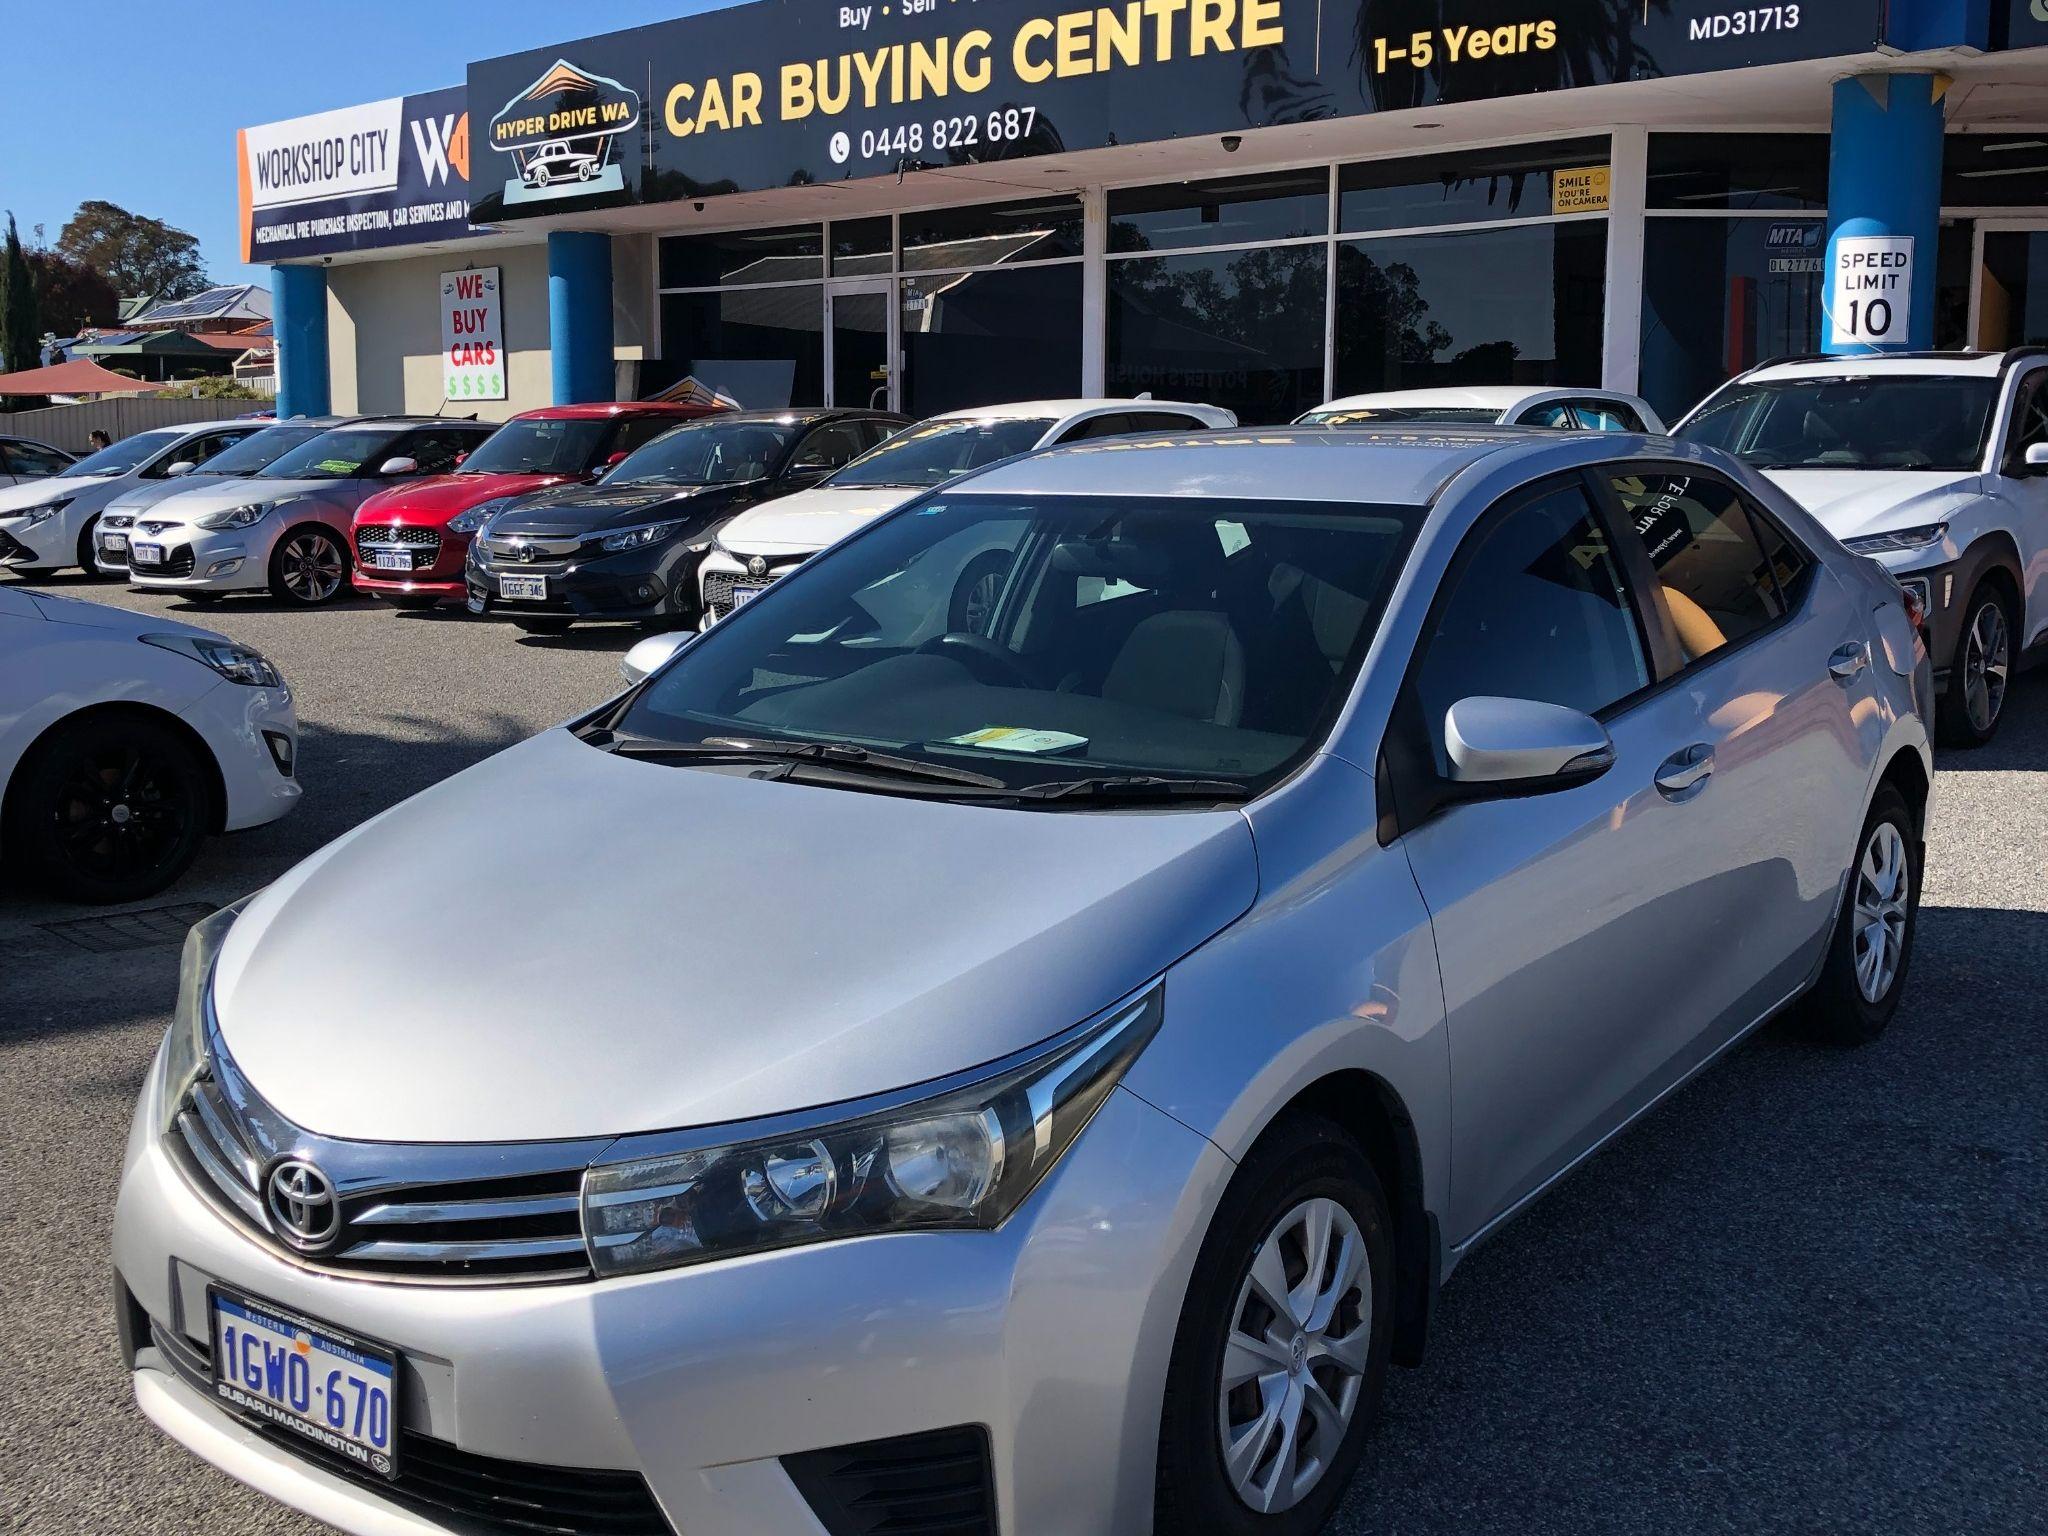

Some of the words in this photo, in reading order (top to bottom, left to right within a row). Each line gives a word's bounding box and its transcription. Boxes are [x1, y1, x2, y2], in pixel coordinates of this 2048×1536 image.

[839, 6, 872, 31] Buy
[902, 0, 936, 16] Sell
[1689, 4, 1800, 40] MD31713
[1442, 19, 1557, 62] Years
[664, 72, 763, 138] CAR
[781, 29, 993, 121] BUYING
[1012, 0, 1284, 84] CENTRE
[496, 116, 545, 141] HYPER
[549, 106, 597, 132] DRIVE
[602, 101, 630, 123] WA
[861, 123, 923, 159] 0448
[932, 115, 978, 149] 822
[986, 106, 1037, 142] 687
[256, 138, 345, 191] WORKSHOP
[351, 128, 389, 176] CITY
[1558, 175, 1591, 189] SMILE
[1558, 188, 1591, 198] YOU'RE
[1558, 199, 1571, 207] ON
[1573, 195, 1608, 206] CAMERA
[256, 225, 296, 244] MECHANICAL
[297, 220, 310, 239] PRE
[311, 215, 346, 237] PURCHASE
[347, 209, 392, 232] INSPECTION,
[393, 206, 409, 226] CAR
[409, 203, 445, 225] SERVICES
[445, 200, 463, 221] AND
[1768, 227, 1803, 244] MTA
[1841, 252, 1907, 269] SPEED
[456, 274, 483, 300] WE
[1845, 274, 1900, 290] LIMIT
[452, 308, 488, 334] BUY
[1849, 298, 1893, 337] 10
[450, 340, 496, 367] CARS
[245, 1310, 285, 1333] WESTERN
[320, 1340, 365, 1365] AUSTRALIA
[218, 1384, 273, 1418] SUBARU
[273, 1406, 368, 1463] MADDINGTON
